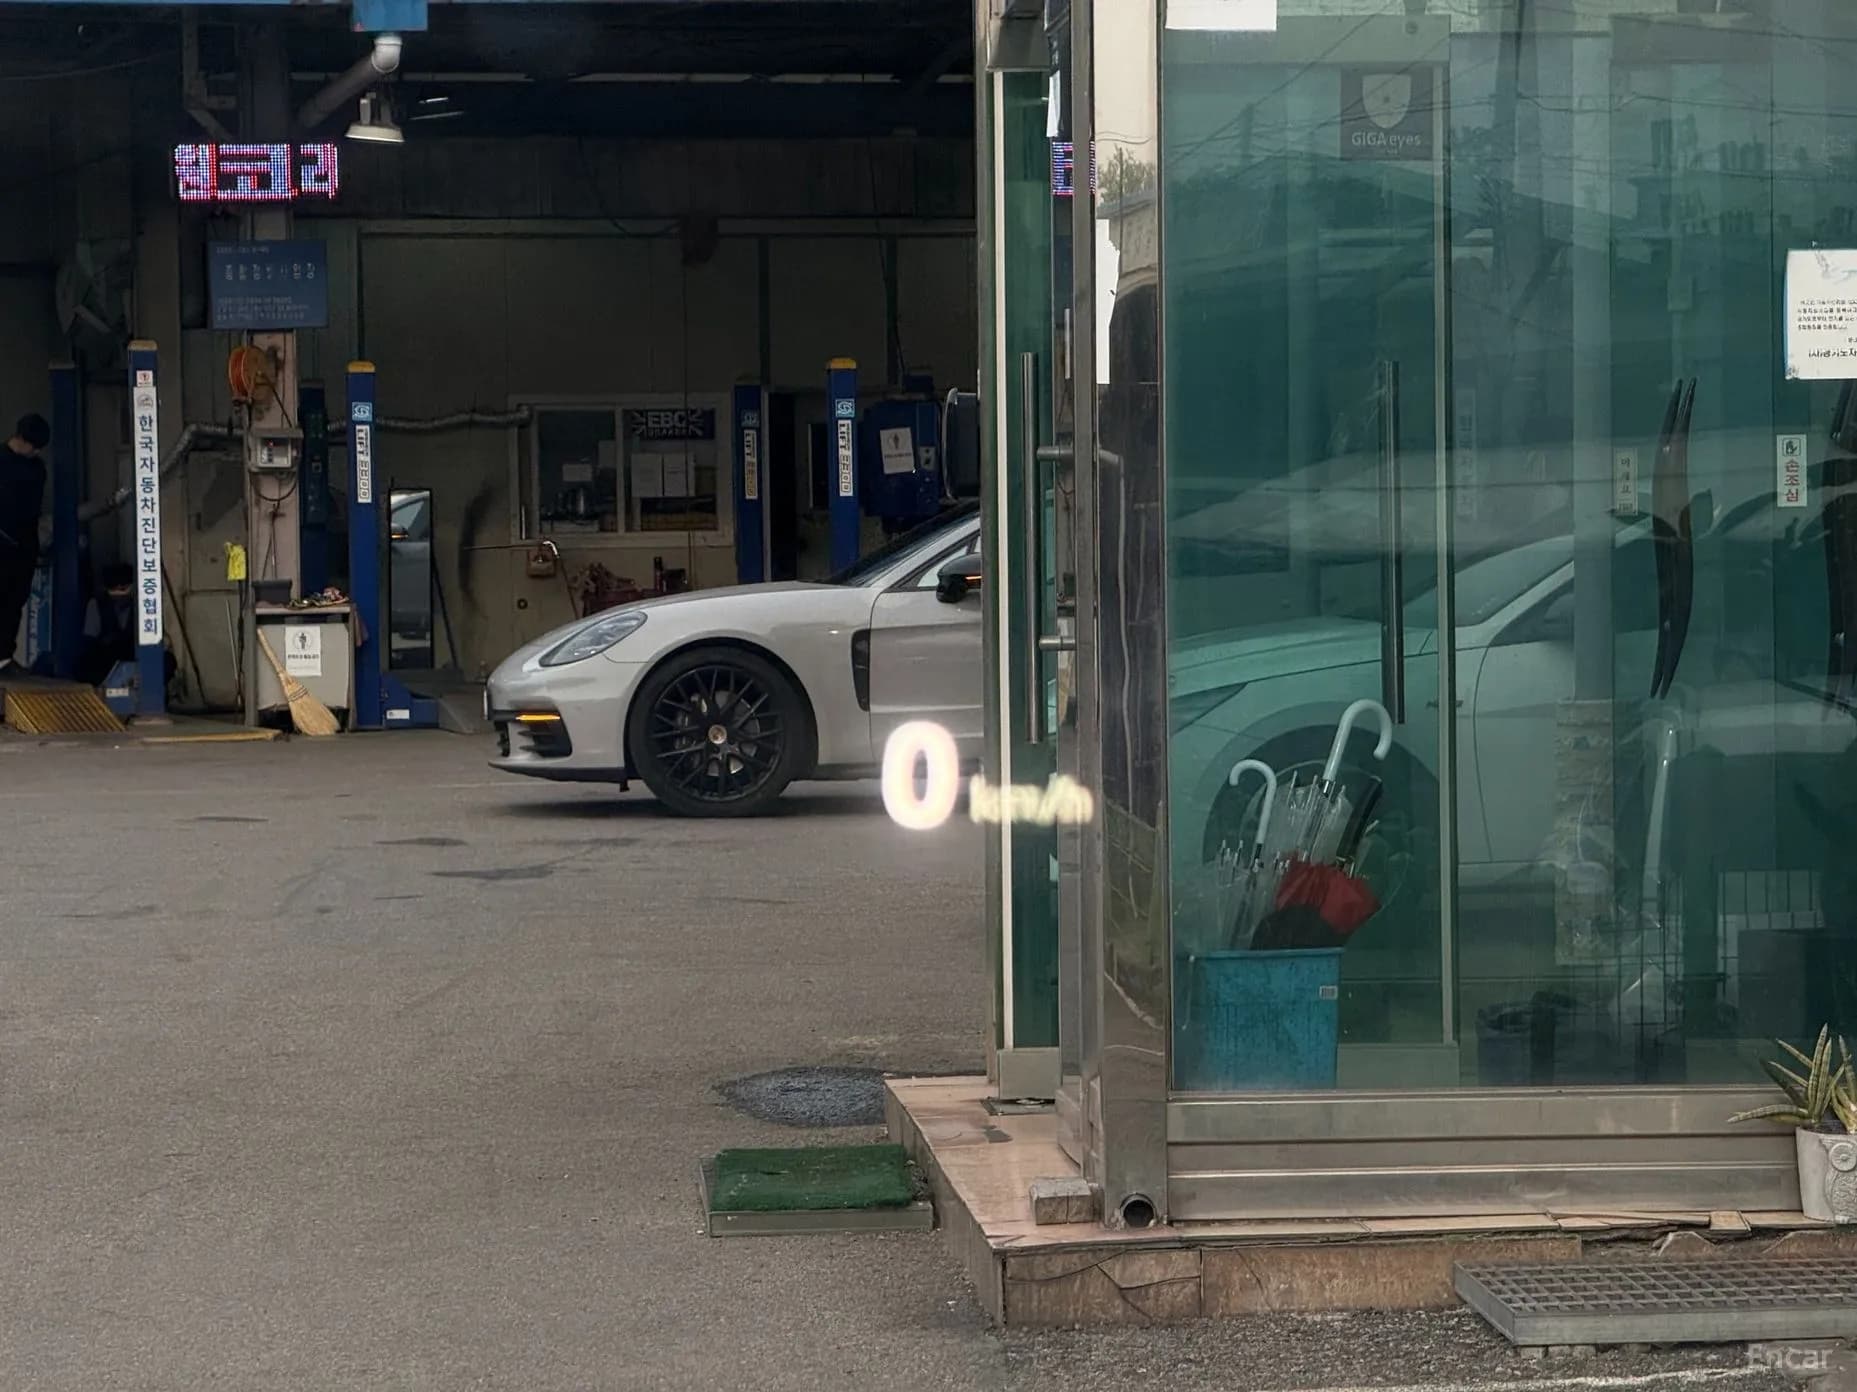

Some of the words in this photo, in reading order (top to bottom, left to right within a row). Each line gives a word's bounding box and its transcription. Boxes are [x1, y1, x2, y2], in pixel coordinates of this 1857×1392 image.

[647, 411, 687, 427] EBC
[1784, 458, 1800, 503] 손조심
[882, 720, 960, 831] 0
